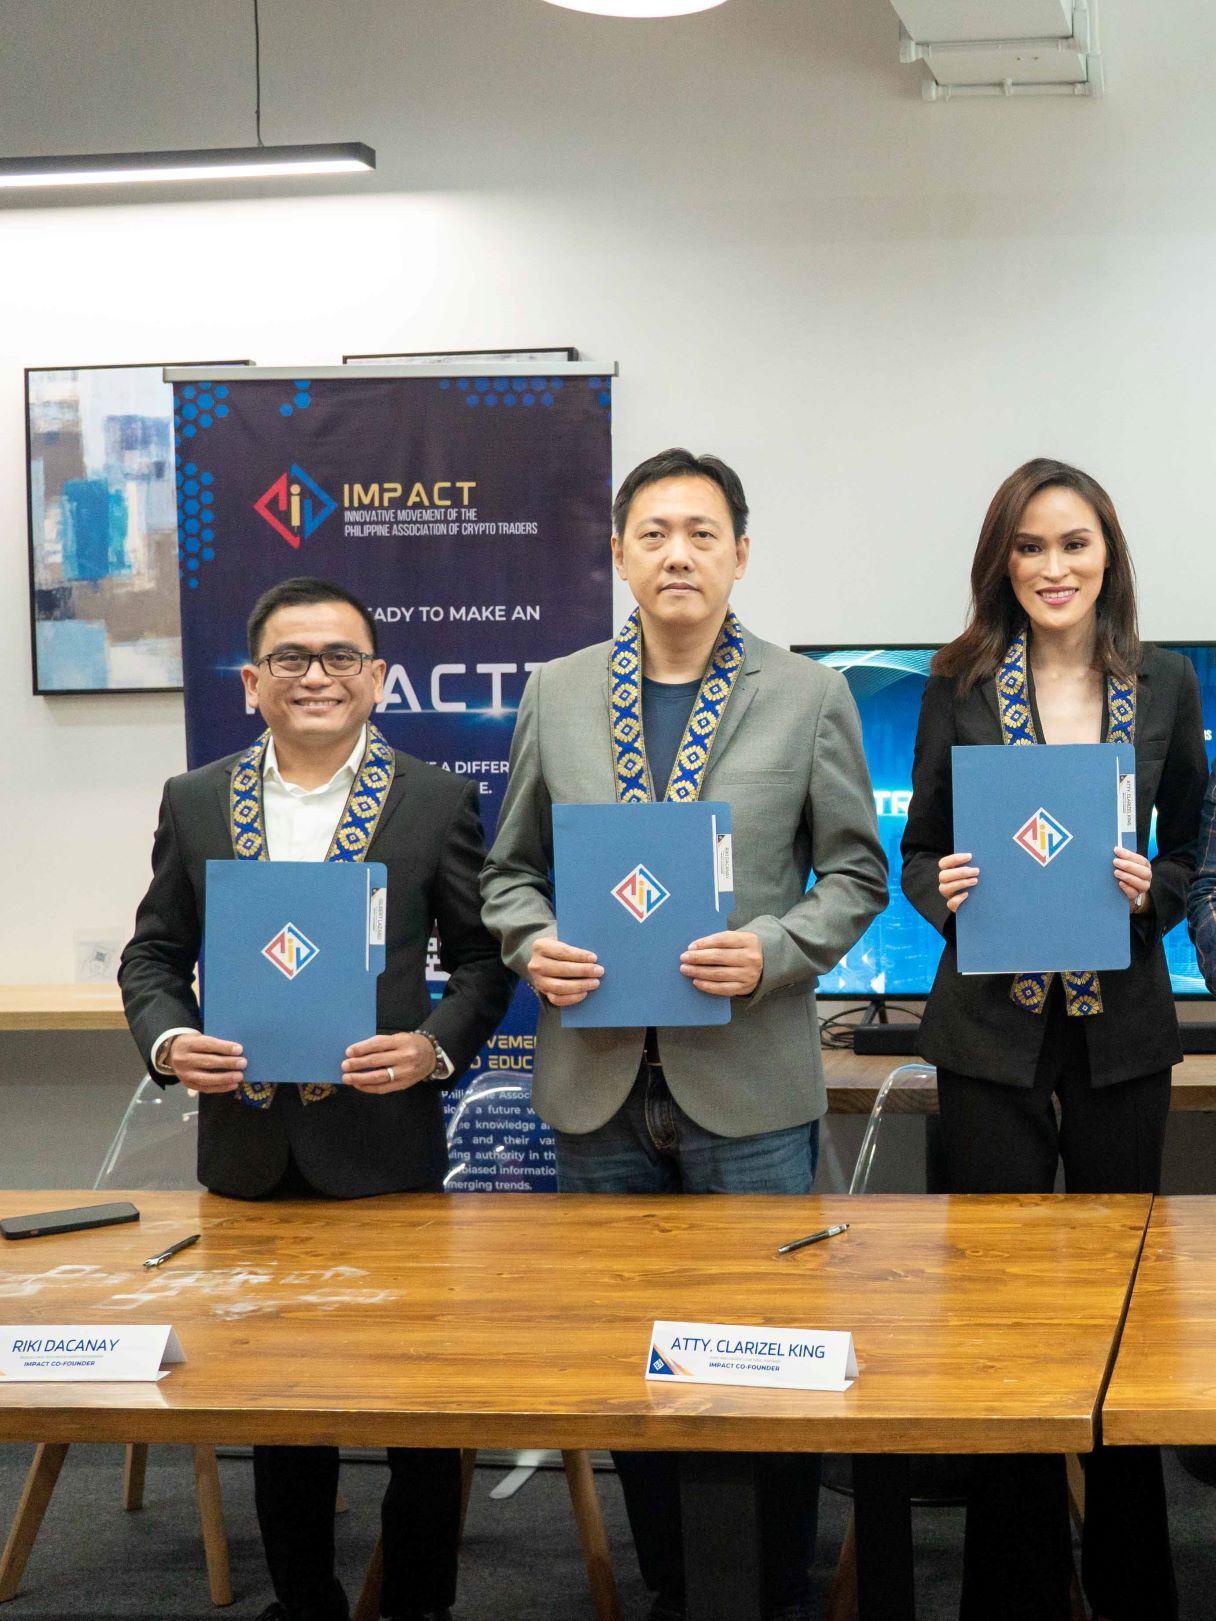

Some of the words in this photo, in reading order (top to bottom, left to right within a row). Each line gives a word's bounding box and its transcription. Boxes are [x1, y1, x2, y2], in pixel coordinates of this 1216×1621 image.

[343, 482, 477, 508] IMPACT
[344, 509, 396, 523] INNOVATIVE
[396, 508, 446, 522] MOVEMENT
[448, 508, 459, 521] OF
[461, 508, 478, 521] THE
[344, 523, 391, 537] PHILIPPINE
[392, 522, 448, 536] ASSOCIATION
[449, 522, 460, 536] OF
[461, 522, 496, 535] CRYPTO
[497, 521, 539, 535] TRADERS
[419, 606, 445, 623] TO
[449, 605, 507, 622] MAKE
[511, 604, 541, 621] AN
[488, 1105, 521, 1115] future
[476, 1121, 536, 1132] knowledge
[472, 1135, 494, 1145] and
[503, 1135, 530, 1145] their
[475, 1150, 526, 1162] authority
[529, 1150, 540, 1160] in
[495, 1180, 533, 1191] trends.
[12, 1339, 43, 1353] RIKI
[43, 1338, 120, 1352] DACANAY
[670, 1337, 713, 1352] ATTY.
[716, 1339, 786, 1357] CLARIZEL
[788, 1343, 826, 1359] KING
[708, 1362, 735, 1370] IMPACT
[735, 1363, 781, 1372] CO-FOUNDER
